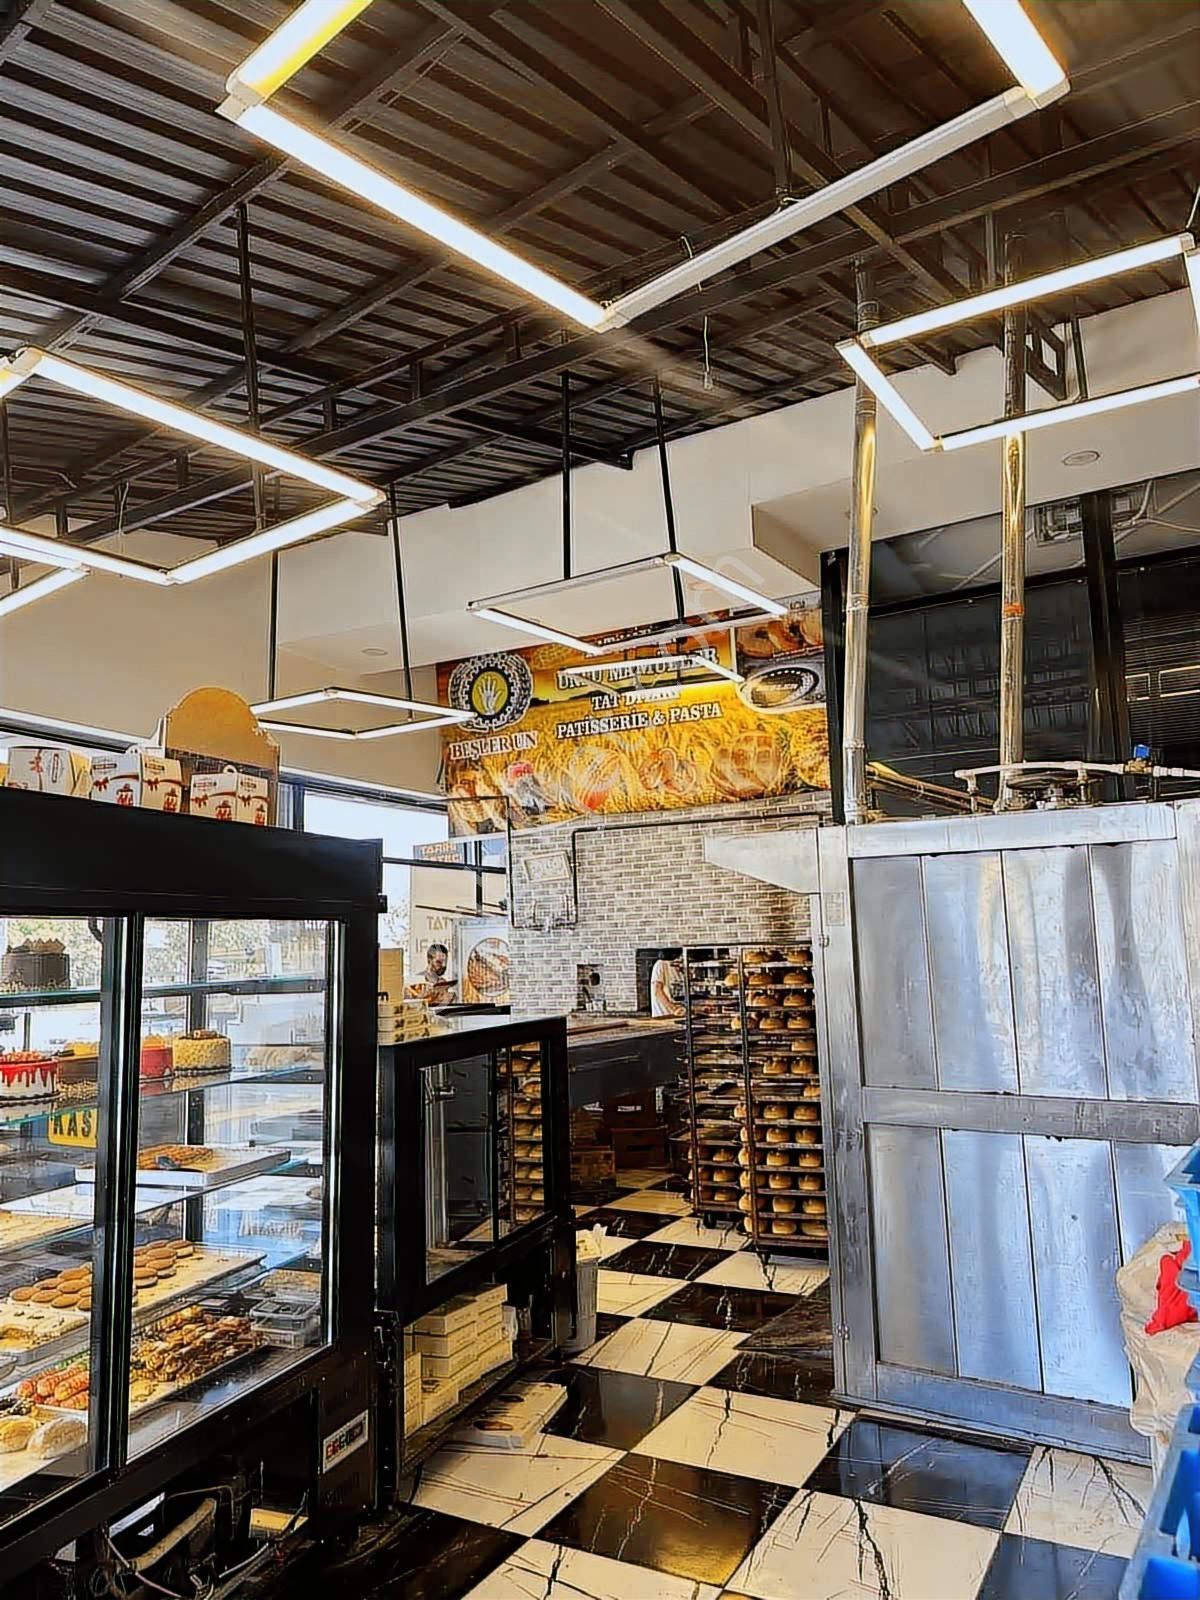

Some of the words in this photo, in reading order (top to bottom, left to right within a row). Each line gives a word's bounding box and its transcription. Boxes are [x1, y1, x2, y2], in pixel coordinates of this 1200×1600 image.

[557, 710, 649, 739] PATİSSERİE
[652, 710, 666, 725] &
[670, 702, 722, 724] PASTA
[513, 731, 538, 751] UN
